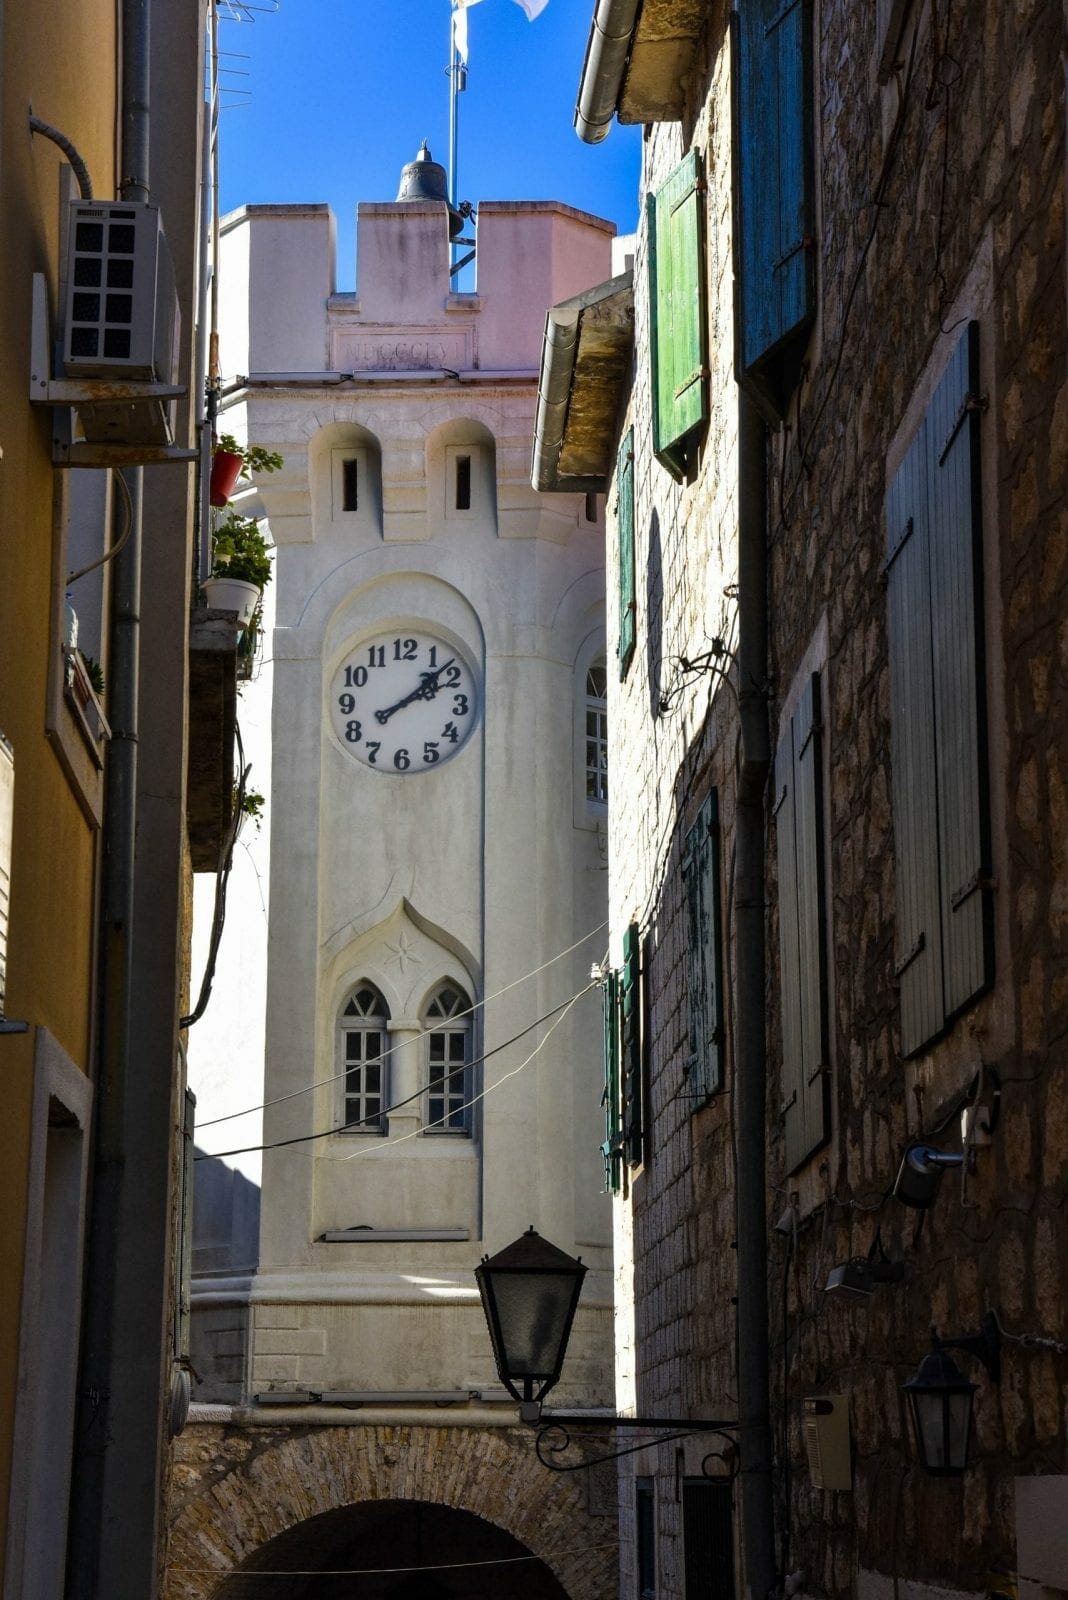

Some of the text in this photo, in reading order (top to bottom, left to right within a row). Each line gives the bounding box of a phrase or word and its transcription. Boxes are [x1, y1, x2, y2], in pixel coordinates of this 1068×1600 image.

[368, 645, 386, 667] 11
[393, 639, 418, 661] 12
[429, 646, 437, 667] 1
[344, 665, 368, 687] 10
[446, 667, 461, 688] 2
[339, 694, 355, 714] 9
[453, 695, 468, 715] 3
[345, 720, 362, 742] 8
[441, 722, 459, 742] 4
[366, 742, 381, 763] 7
[394, 749, 410, 770] 6
[424, 742, 439, 762] 5
